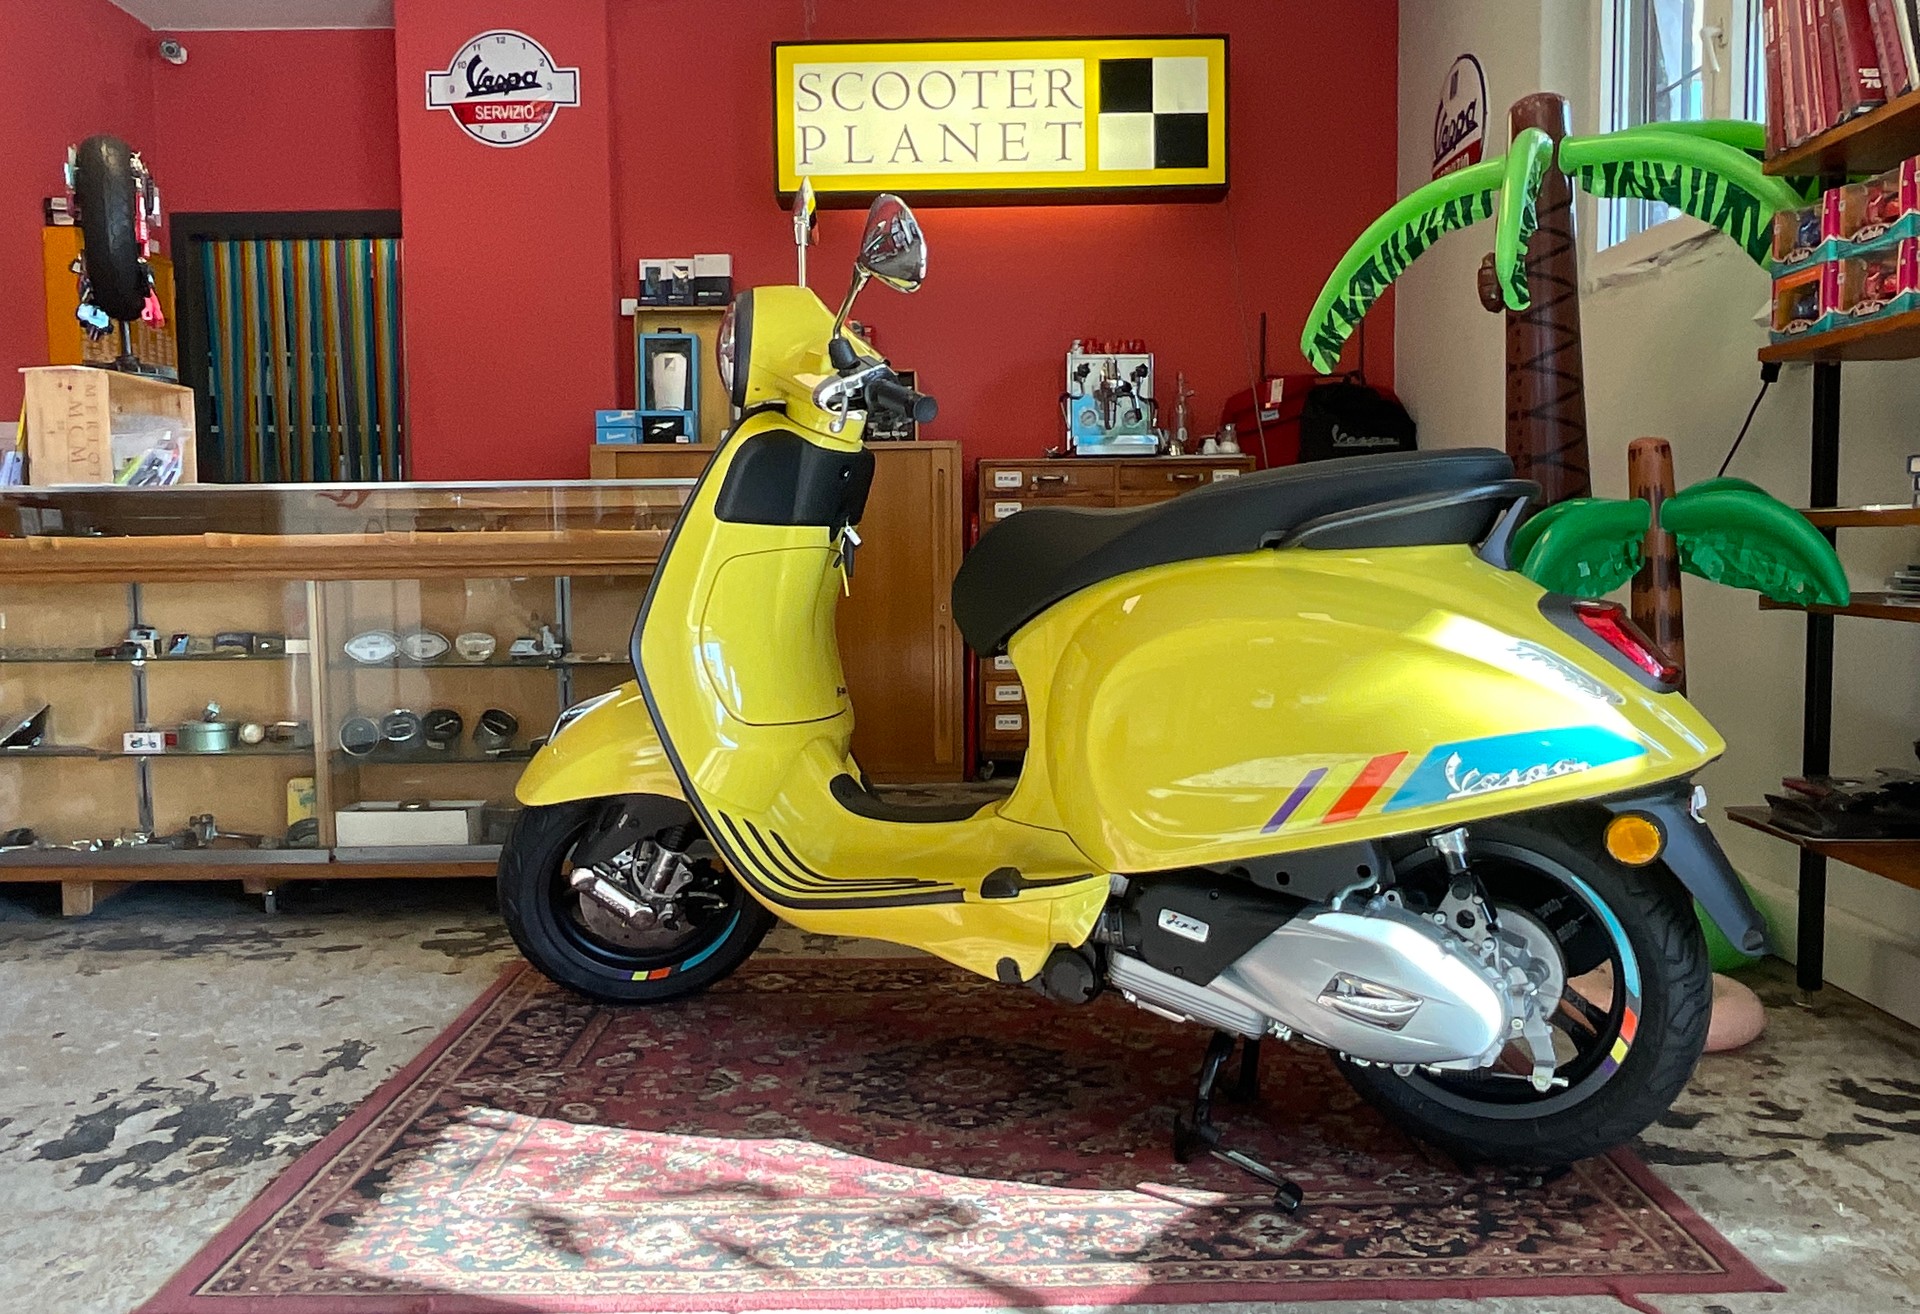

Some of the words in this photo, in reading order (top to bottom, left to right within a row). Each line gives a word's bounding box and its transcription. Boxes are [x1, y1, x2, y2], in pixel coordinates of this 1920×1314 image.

[496, 36, 506, 45] 12
[472, 43, 481, 51] 11
[457, 60, 467, 69] 10
[539, 58, 545, 67] 2
[465, 54, 543, 98] Vespa
[547, 82, 553, 91] 3
[797, 67, 1083, 113] SCOOTER
[475, 105, 535, 120] SERVIZIO
[523, 124, 530, 133] 5
[1433, 98, 1478, 168] Vespa
[501, 130, 507, 140] 6
[797, 121, 1083, 166] PLANET
